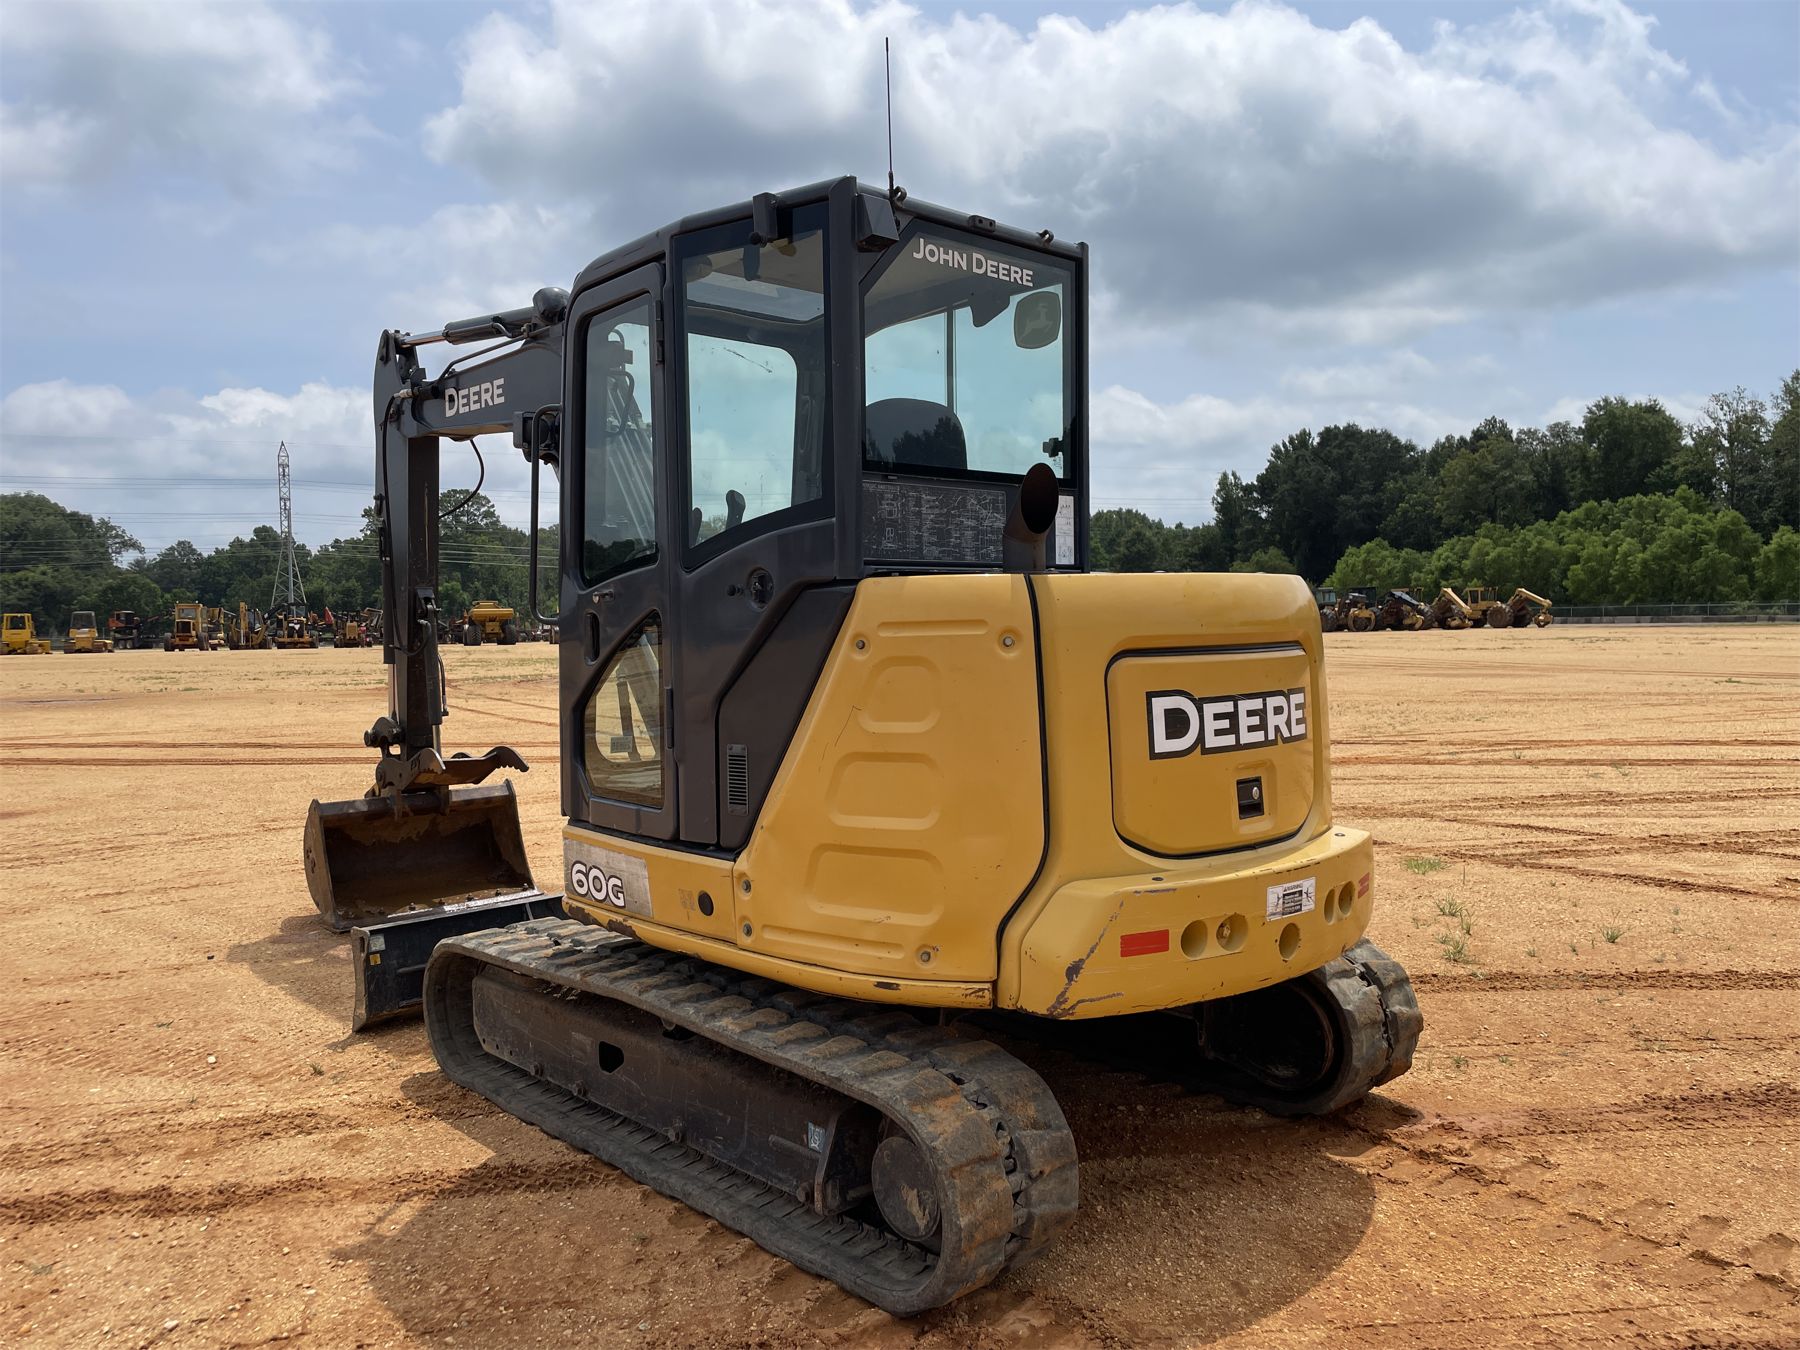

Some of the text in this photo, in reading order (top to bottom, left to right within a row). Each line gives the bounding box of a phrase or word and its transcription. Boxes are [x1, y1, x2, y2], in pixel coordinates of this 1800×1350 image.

[913, 237, 1033, 287] JOHN DEERE
[444, 377, 504, 418] DEERE
[1149, 691, 1307, 755] DEERE
[571, 861, 626, 908] 60G
